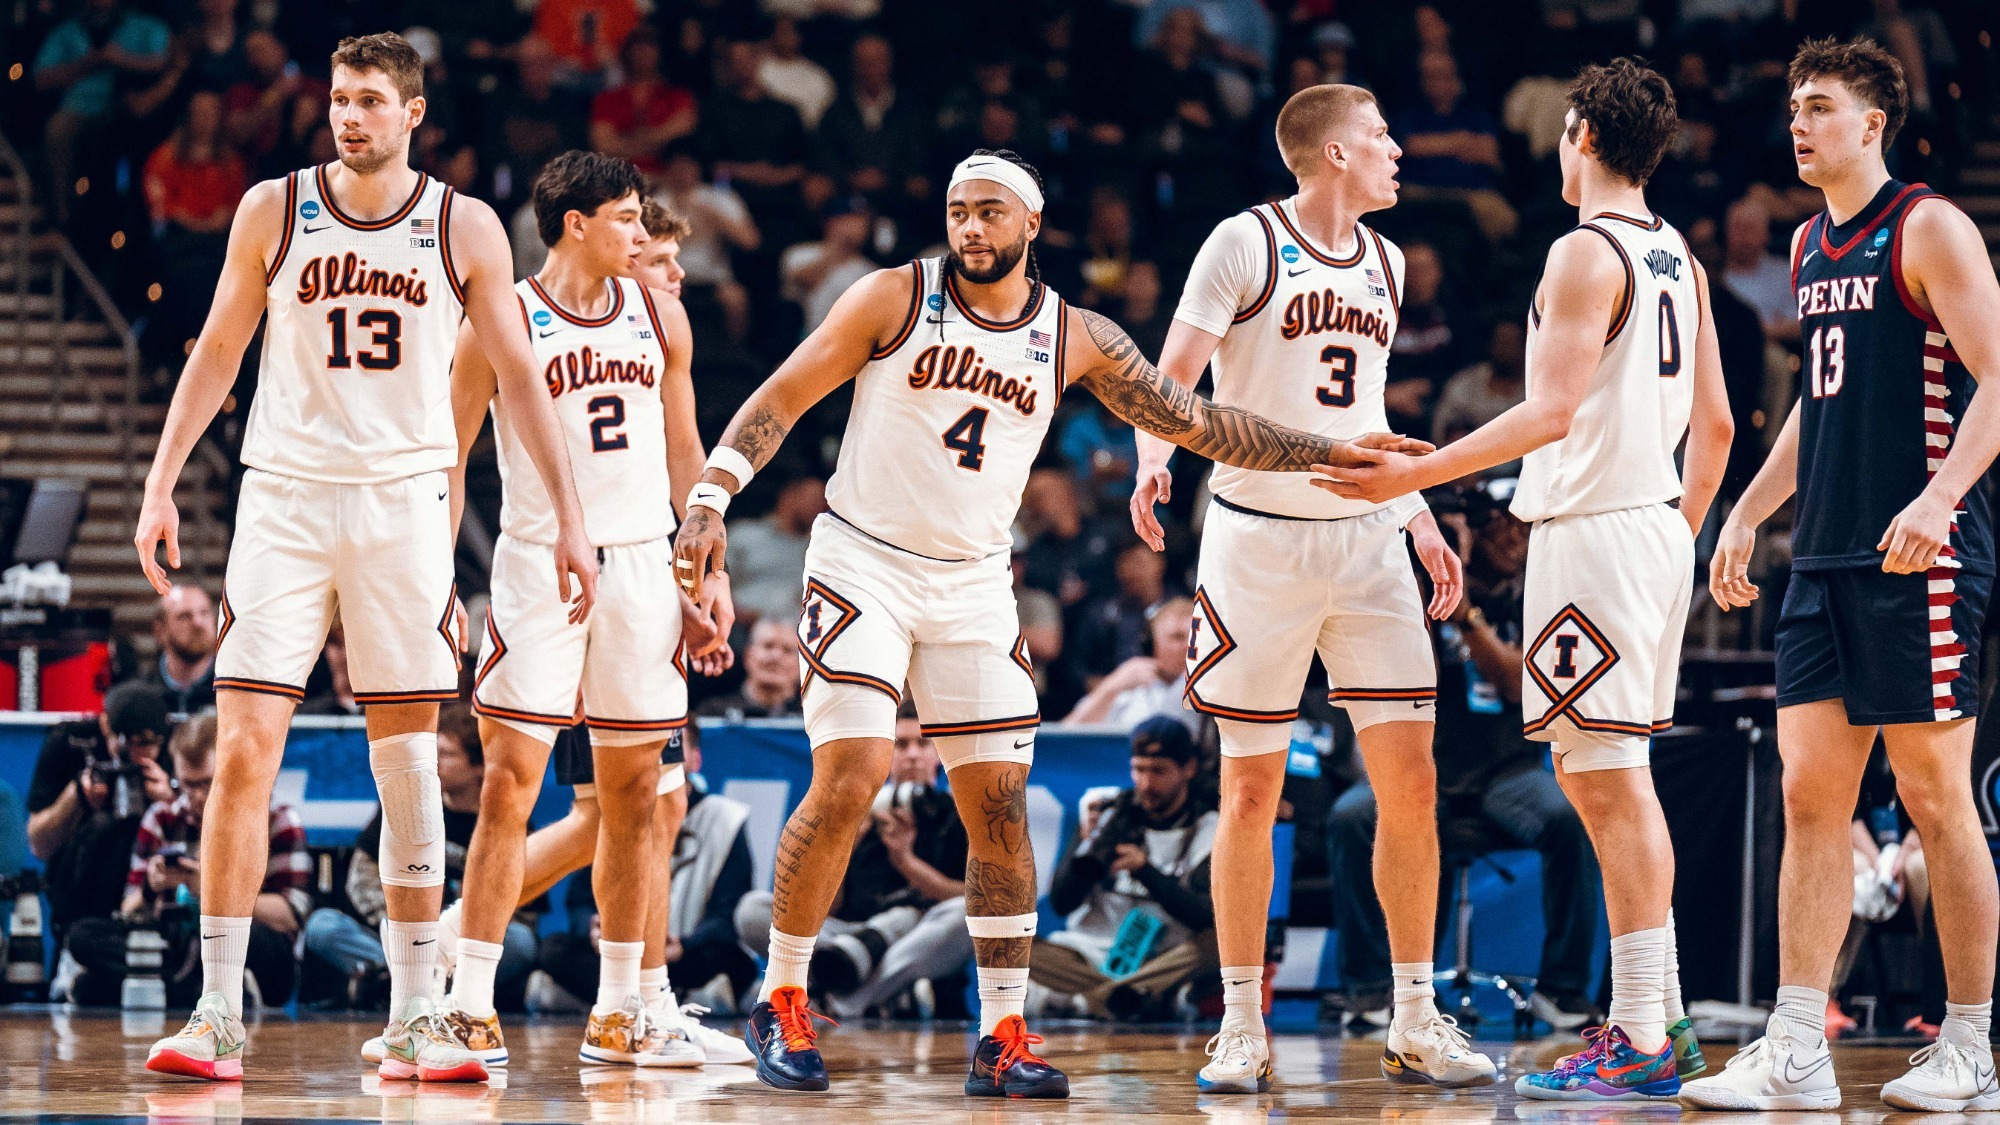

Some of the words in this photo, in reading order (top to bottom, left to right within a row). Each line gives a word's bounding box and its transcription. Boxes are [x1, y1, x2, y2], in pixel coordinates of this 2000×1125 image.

[297, 251, 428, 307] Illinois
[1797, 275, 1880, 321] PENN
[327, 306, 401, 371] 13
[1281, 288, 1388, 347] Illinois
[1658, 290, 1682, 378] 0
[545, 345, 655, 399] Illinois
[908, 345, 1038, 417] Illinois
[1315, 344, 1358, 409] 3
[1810, 324, 1845, 399] 13
[587, 394, 629, 453] 2
[941, 405, 990, 472] 4
[807, 599, 823, 645] I
[1553, 634, 1579, 679] I
